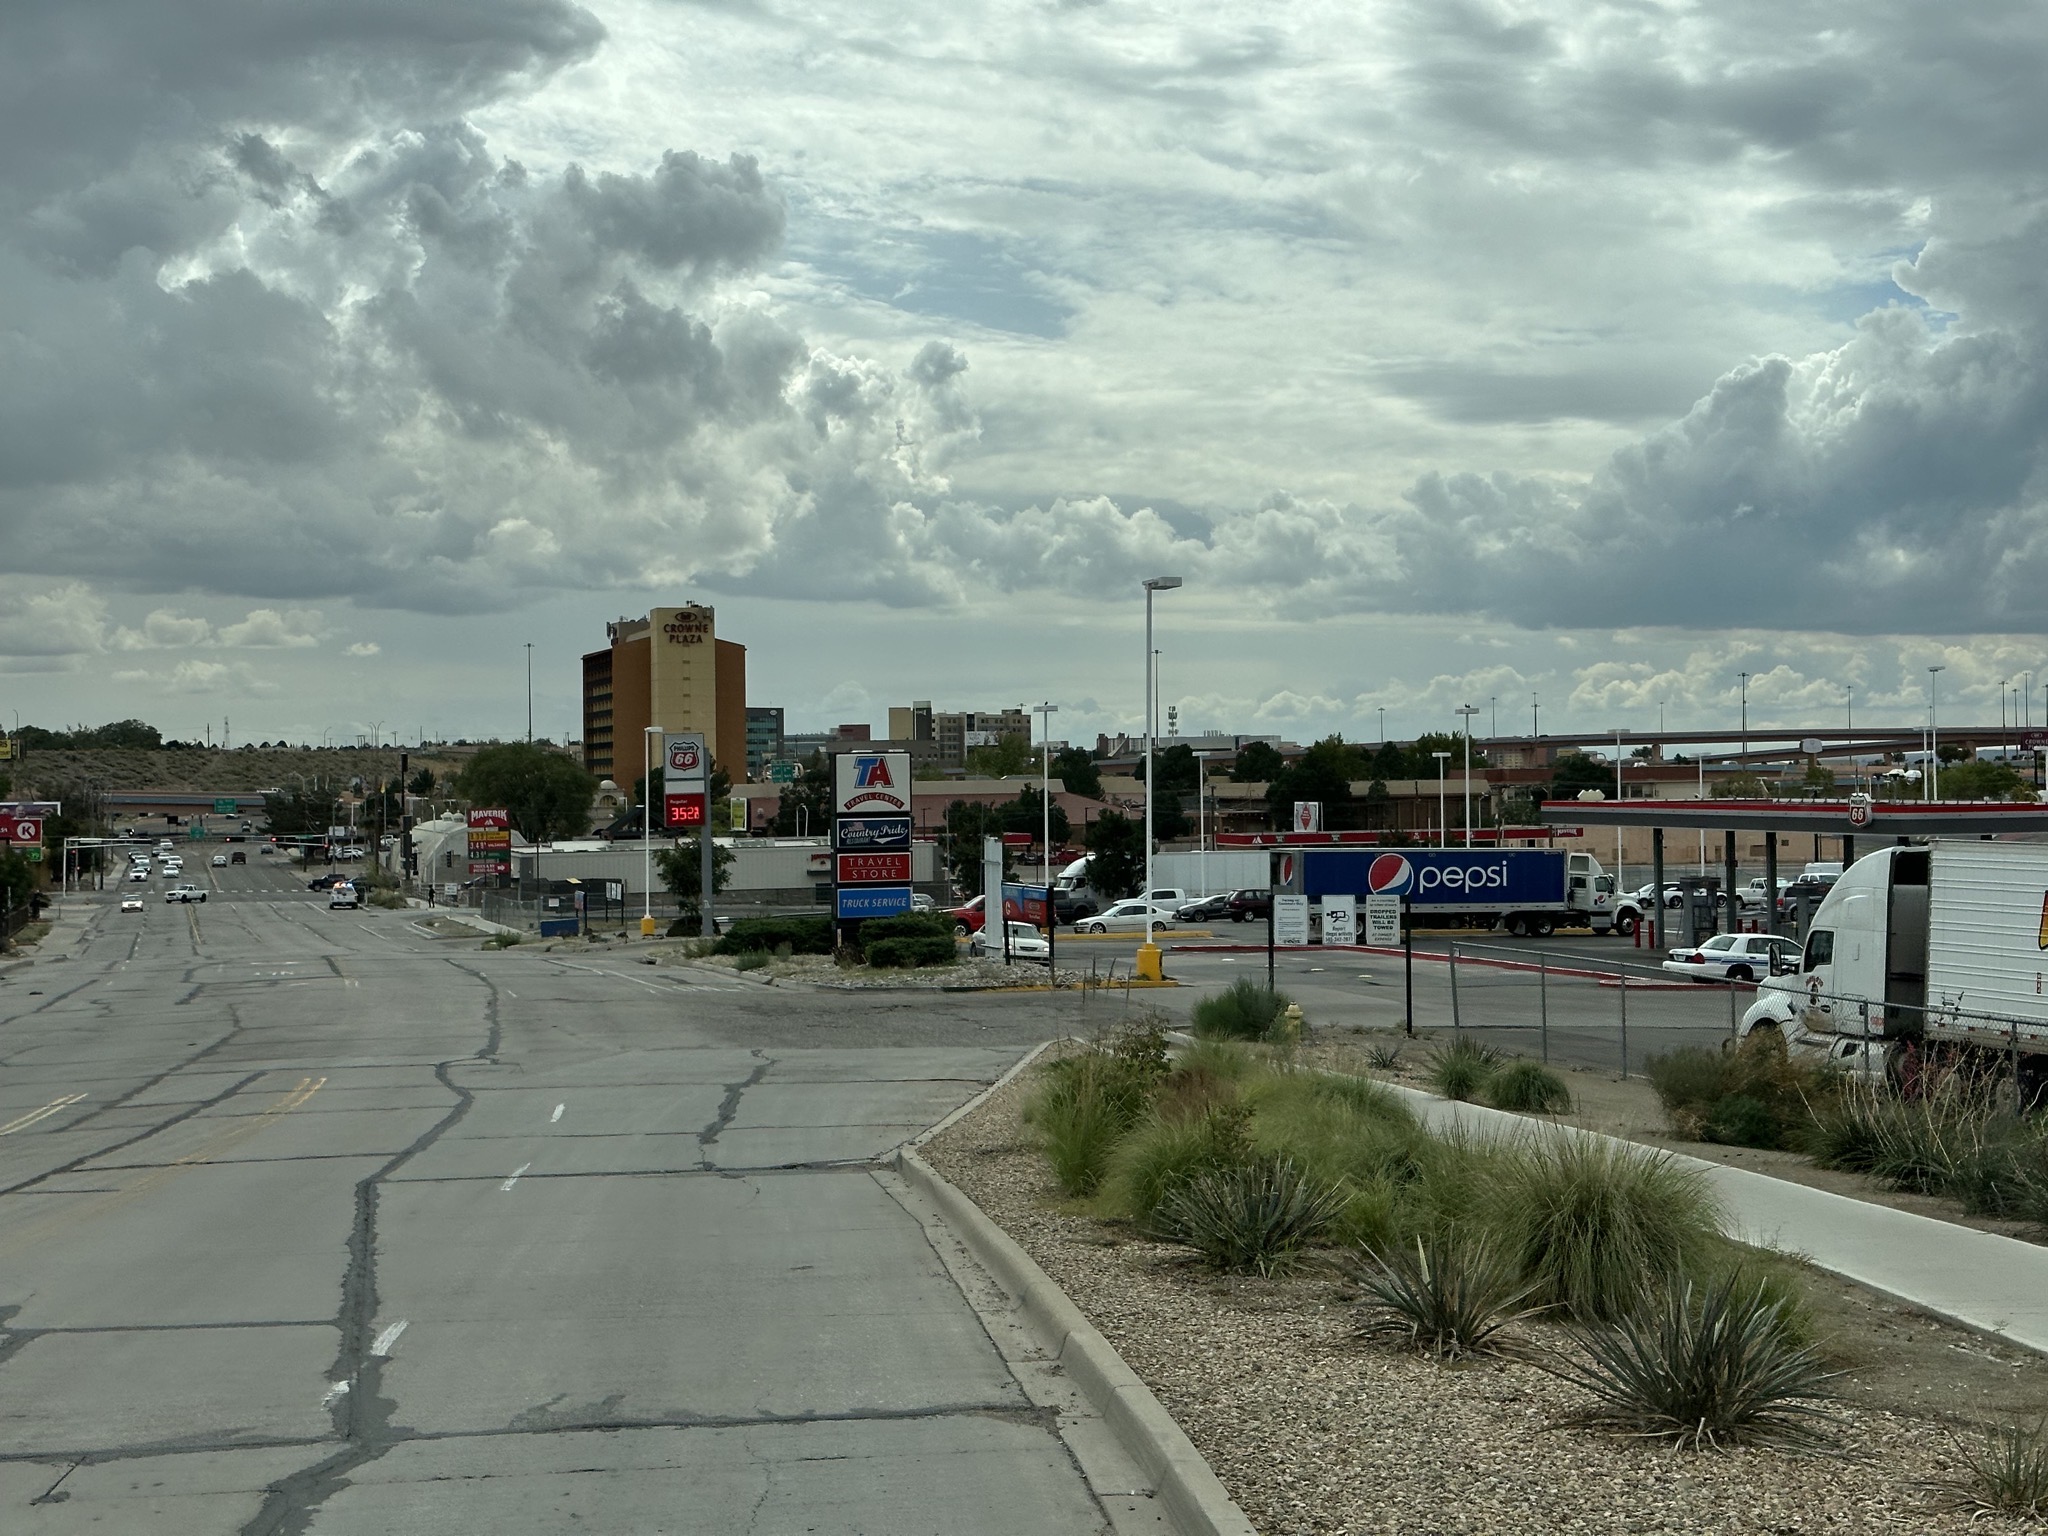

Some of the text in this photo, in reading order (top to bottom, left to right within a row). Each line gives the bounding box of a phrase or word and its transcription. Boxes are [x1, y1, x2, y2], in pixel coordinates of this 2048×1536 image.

[664, 623, 709, 633] CROWNE
[669, 634, 703, 644] PLAZA
[675, 753, 694, 765] 66
[854, 756, 894, 788] TA
[846, 793, 902, 808] TRAVEL CENTER
[471, 809, 508, 822] MAVERIK
[1851, 808, 1864, 821] 66
[841, 824, 907, 839] Country Pride
[849, 857, 901, 866] TRAVEL
[852, 869, 897, 879] STORE
[1420, 860, 1508, 894] pepsi
[842, 897, 907, 908] TRUCK SERVICE
